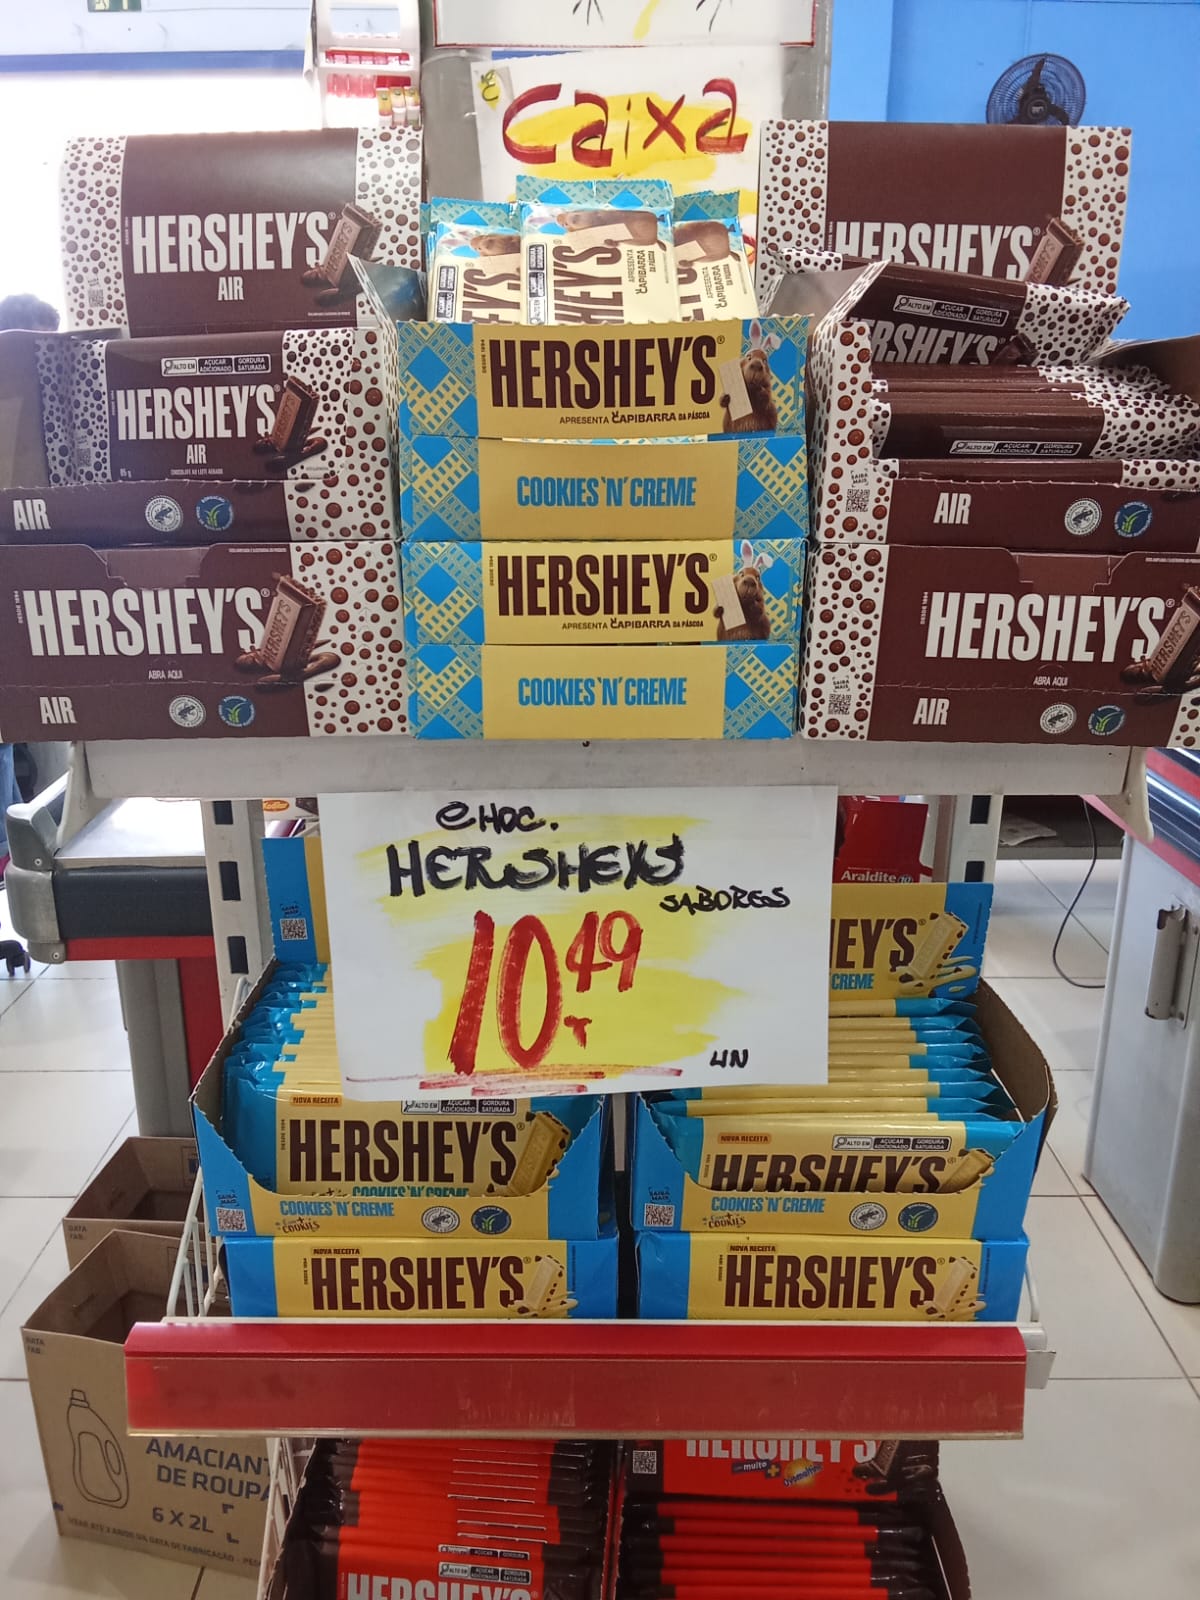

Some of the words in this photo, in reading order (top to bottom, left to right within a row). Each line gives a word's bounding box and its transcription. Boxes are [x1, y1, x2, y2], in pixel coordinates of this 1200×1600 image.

[502, 78, 748, 168] Caixa
[131, 211, 329, 275] HERSHEY'S
[217, 276, 245, 301] AIR
[907, 302, 922, 310] ALTO
[849, 317, 998, 364] RSHEY'S
[488, 335, 717, 409] HERSHEY'S
[117, 384, 276, 441] HERSHEY'S
[559, 416, 609, 425] APRESENTA
[611, 411, 677, 424] CAPIBARRA
[678, 413, 686, 421] DA
[186, 444, 208, 465] AIR
[516, 476, 600, 507] COOKIES
[629, 476, 698, 507] CREME
[13, 498, 51, 531] AIR
[933, 492, 971, 525] AIR
[497, 553, 710, 617] HERSHEY'S
[22, 586, 267, 656] HERSHEY'S
[562, 622, 608, 630] APRESENTA
[610, 618, 671, 630] CAPIBARRA
[925, 591, 1165, 662] HERSHEY'S
[148, 670, 166, 680] ABRA
[1033, 675, 1050, 686] ABRA
[1052, 676, 1068, 686] AQUI
[518, 677, 596, 706] COOKIES
[623, 677, 687, 706] CREME
[39, 696, 77, 725] AIR
[913, 698, 950, 726] AIR
[841, 870, 897, 883] Araldite
[831, 973, 875, 990] CREME
[292, 1096, 311, 1104] NOVA
[312, 1096, 339, 1104] RECEITA
[289, 1119, 517, 1185] HERSHEY'S
[720, 1135, 740, 1143] NOVA
[710, 1154, 946, 1193] HERSHEY'S
[280, 1201, 333, 1216] COOKIES
[352, 1201, 394, 1217] CREME
[711, 1197, 764, 1212] COOKIES
[783, 1198, 825, 1213] CREME
[311, 1255, 524, 1311] HERSHEY'S
[724, 1254, 938, 1309] HERSHEY'S
[157, 1464, 187, 1487] DE
[743, 1460, 768, 1471] muito
[152, 1507, 164, 1523] 6
[169, 1509, 184, 1527] X
[189, 1514, 214, 1533] 2L
